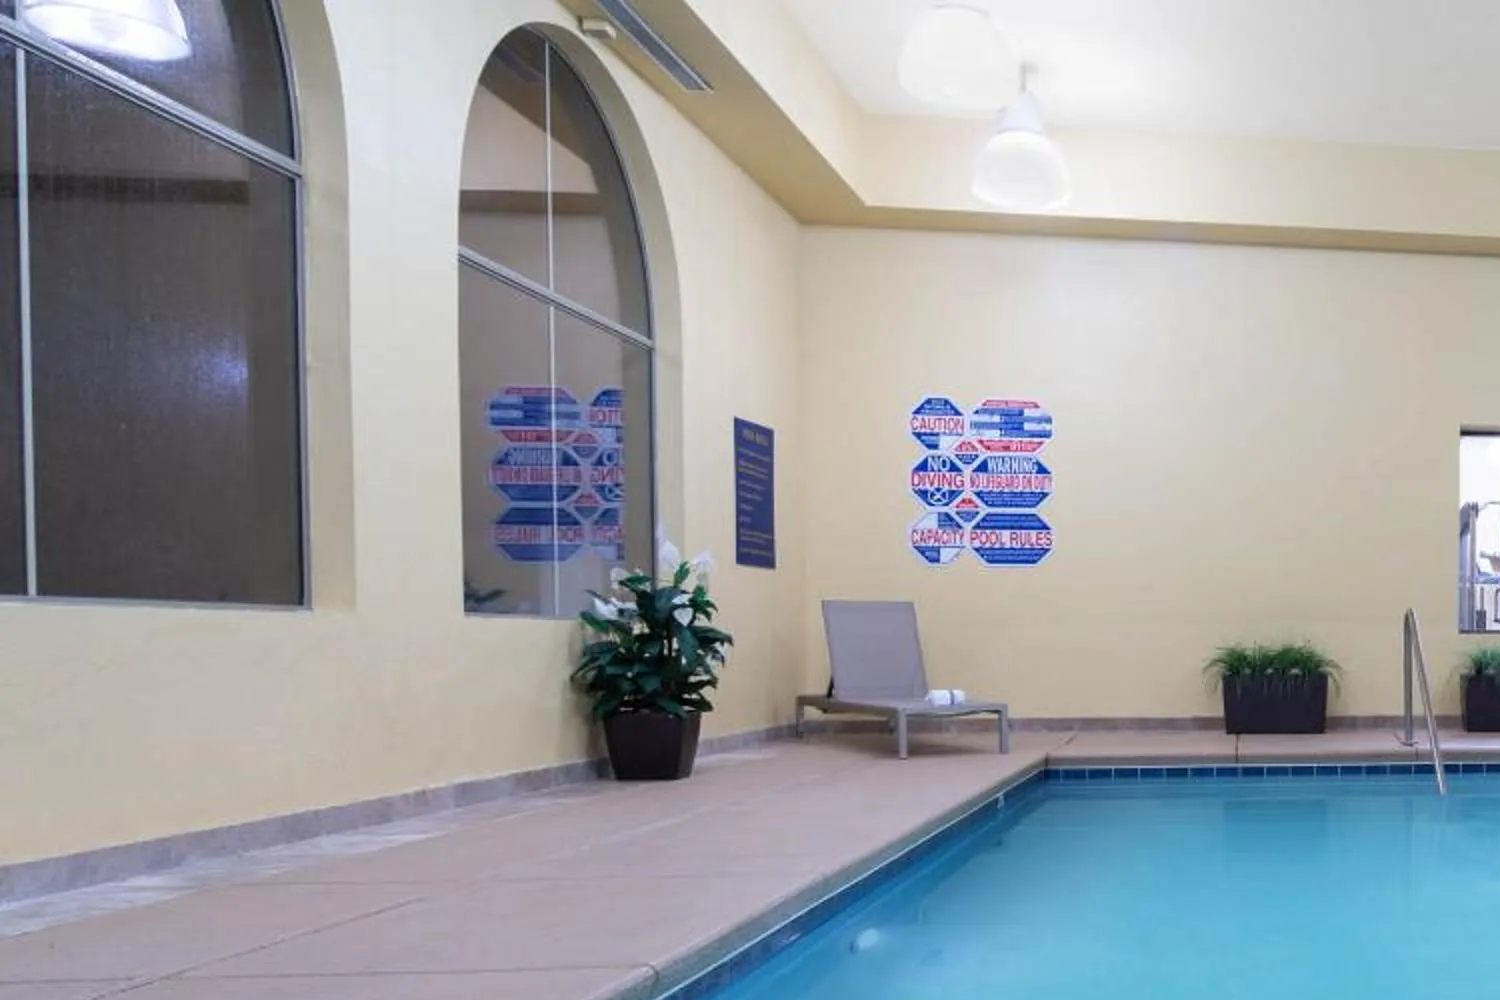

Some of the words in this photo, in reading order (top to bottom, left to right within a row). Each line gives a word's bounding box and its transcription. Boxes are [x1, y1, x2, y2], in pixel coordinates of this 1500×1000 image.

[910, 416, 965, 433] CAUTION
[927, 457, 951, 471] NO
[987, 457, 1038, 473] WARNING
[911, 473, 965, 489] DIVING
[981, 474, 1020, 490] LIFEGUARD
[911, 529, 965, 545] CAPACITY
[970, 532, 1007, 546] POOL
[1009, 532, 1053, 547] RULES
